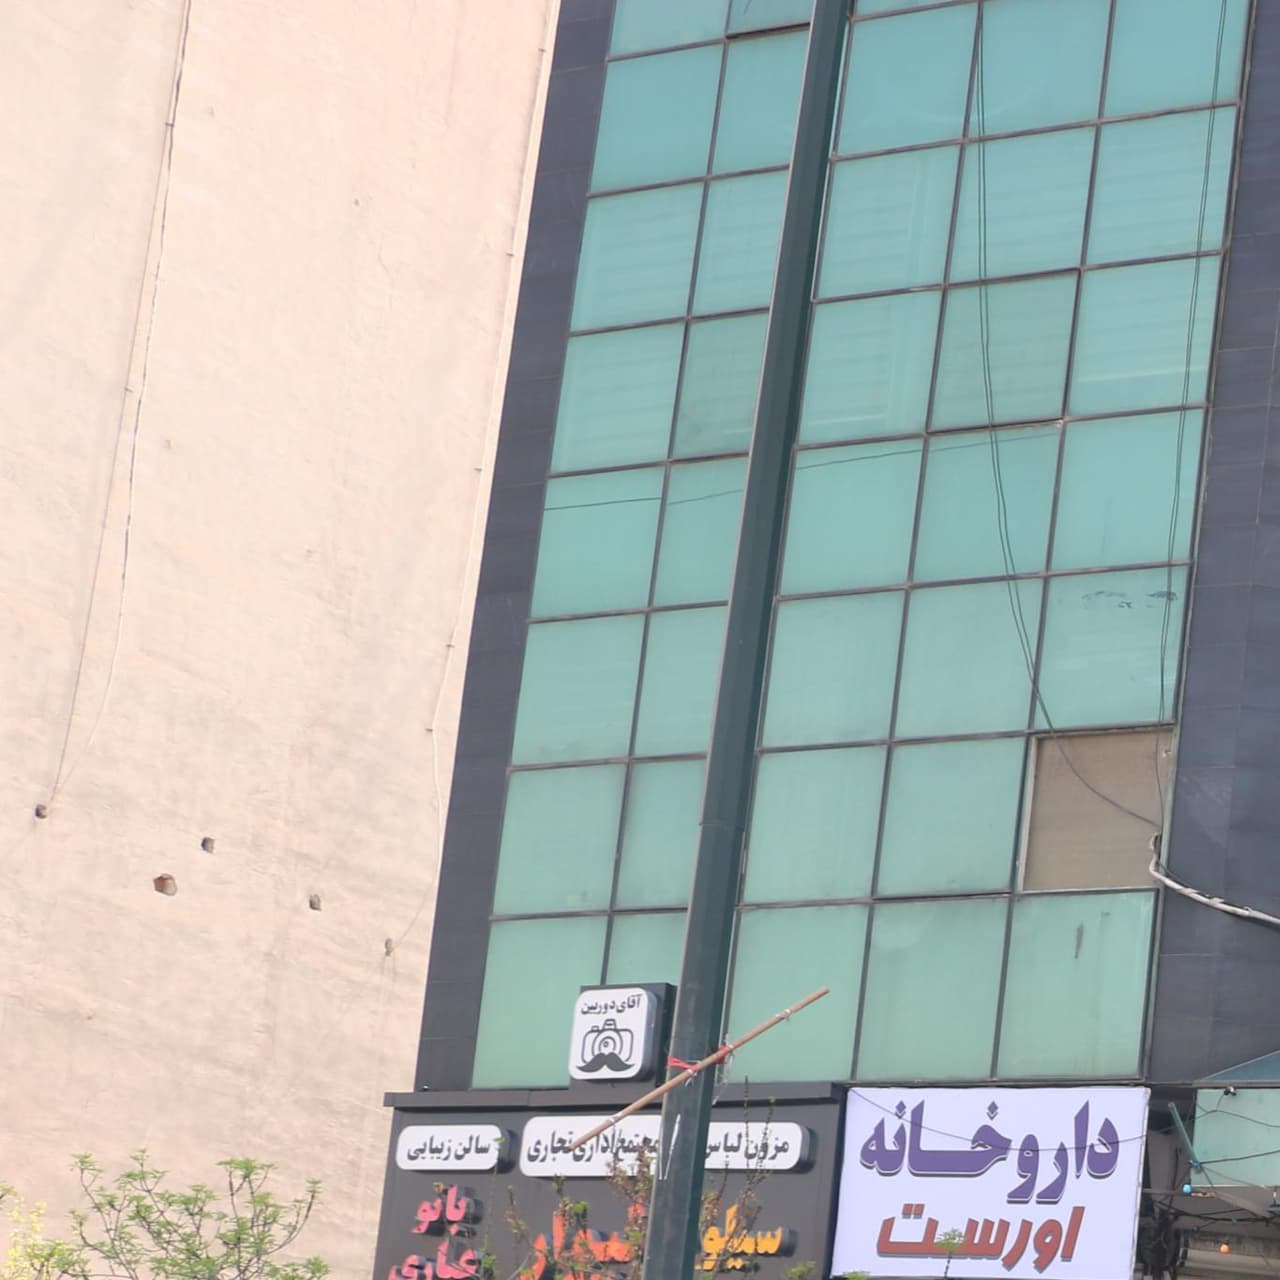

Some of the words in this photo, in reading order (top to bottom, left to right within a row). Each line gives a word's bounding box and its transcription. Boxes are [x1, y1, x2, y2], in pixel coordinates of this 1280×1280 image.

[581, 1000, 616, 1015] دوربین
[616, 993, 643, 1013] آقای
[407, 1134, 453, 1161] زیبایی
[454, 1134, 490, 1161] سالن
[744, 1136, 789, 1161] مزون
[860, 1099, 1121, 1204] داروخانه
[876, 1203, 1086, 1273] اورست
